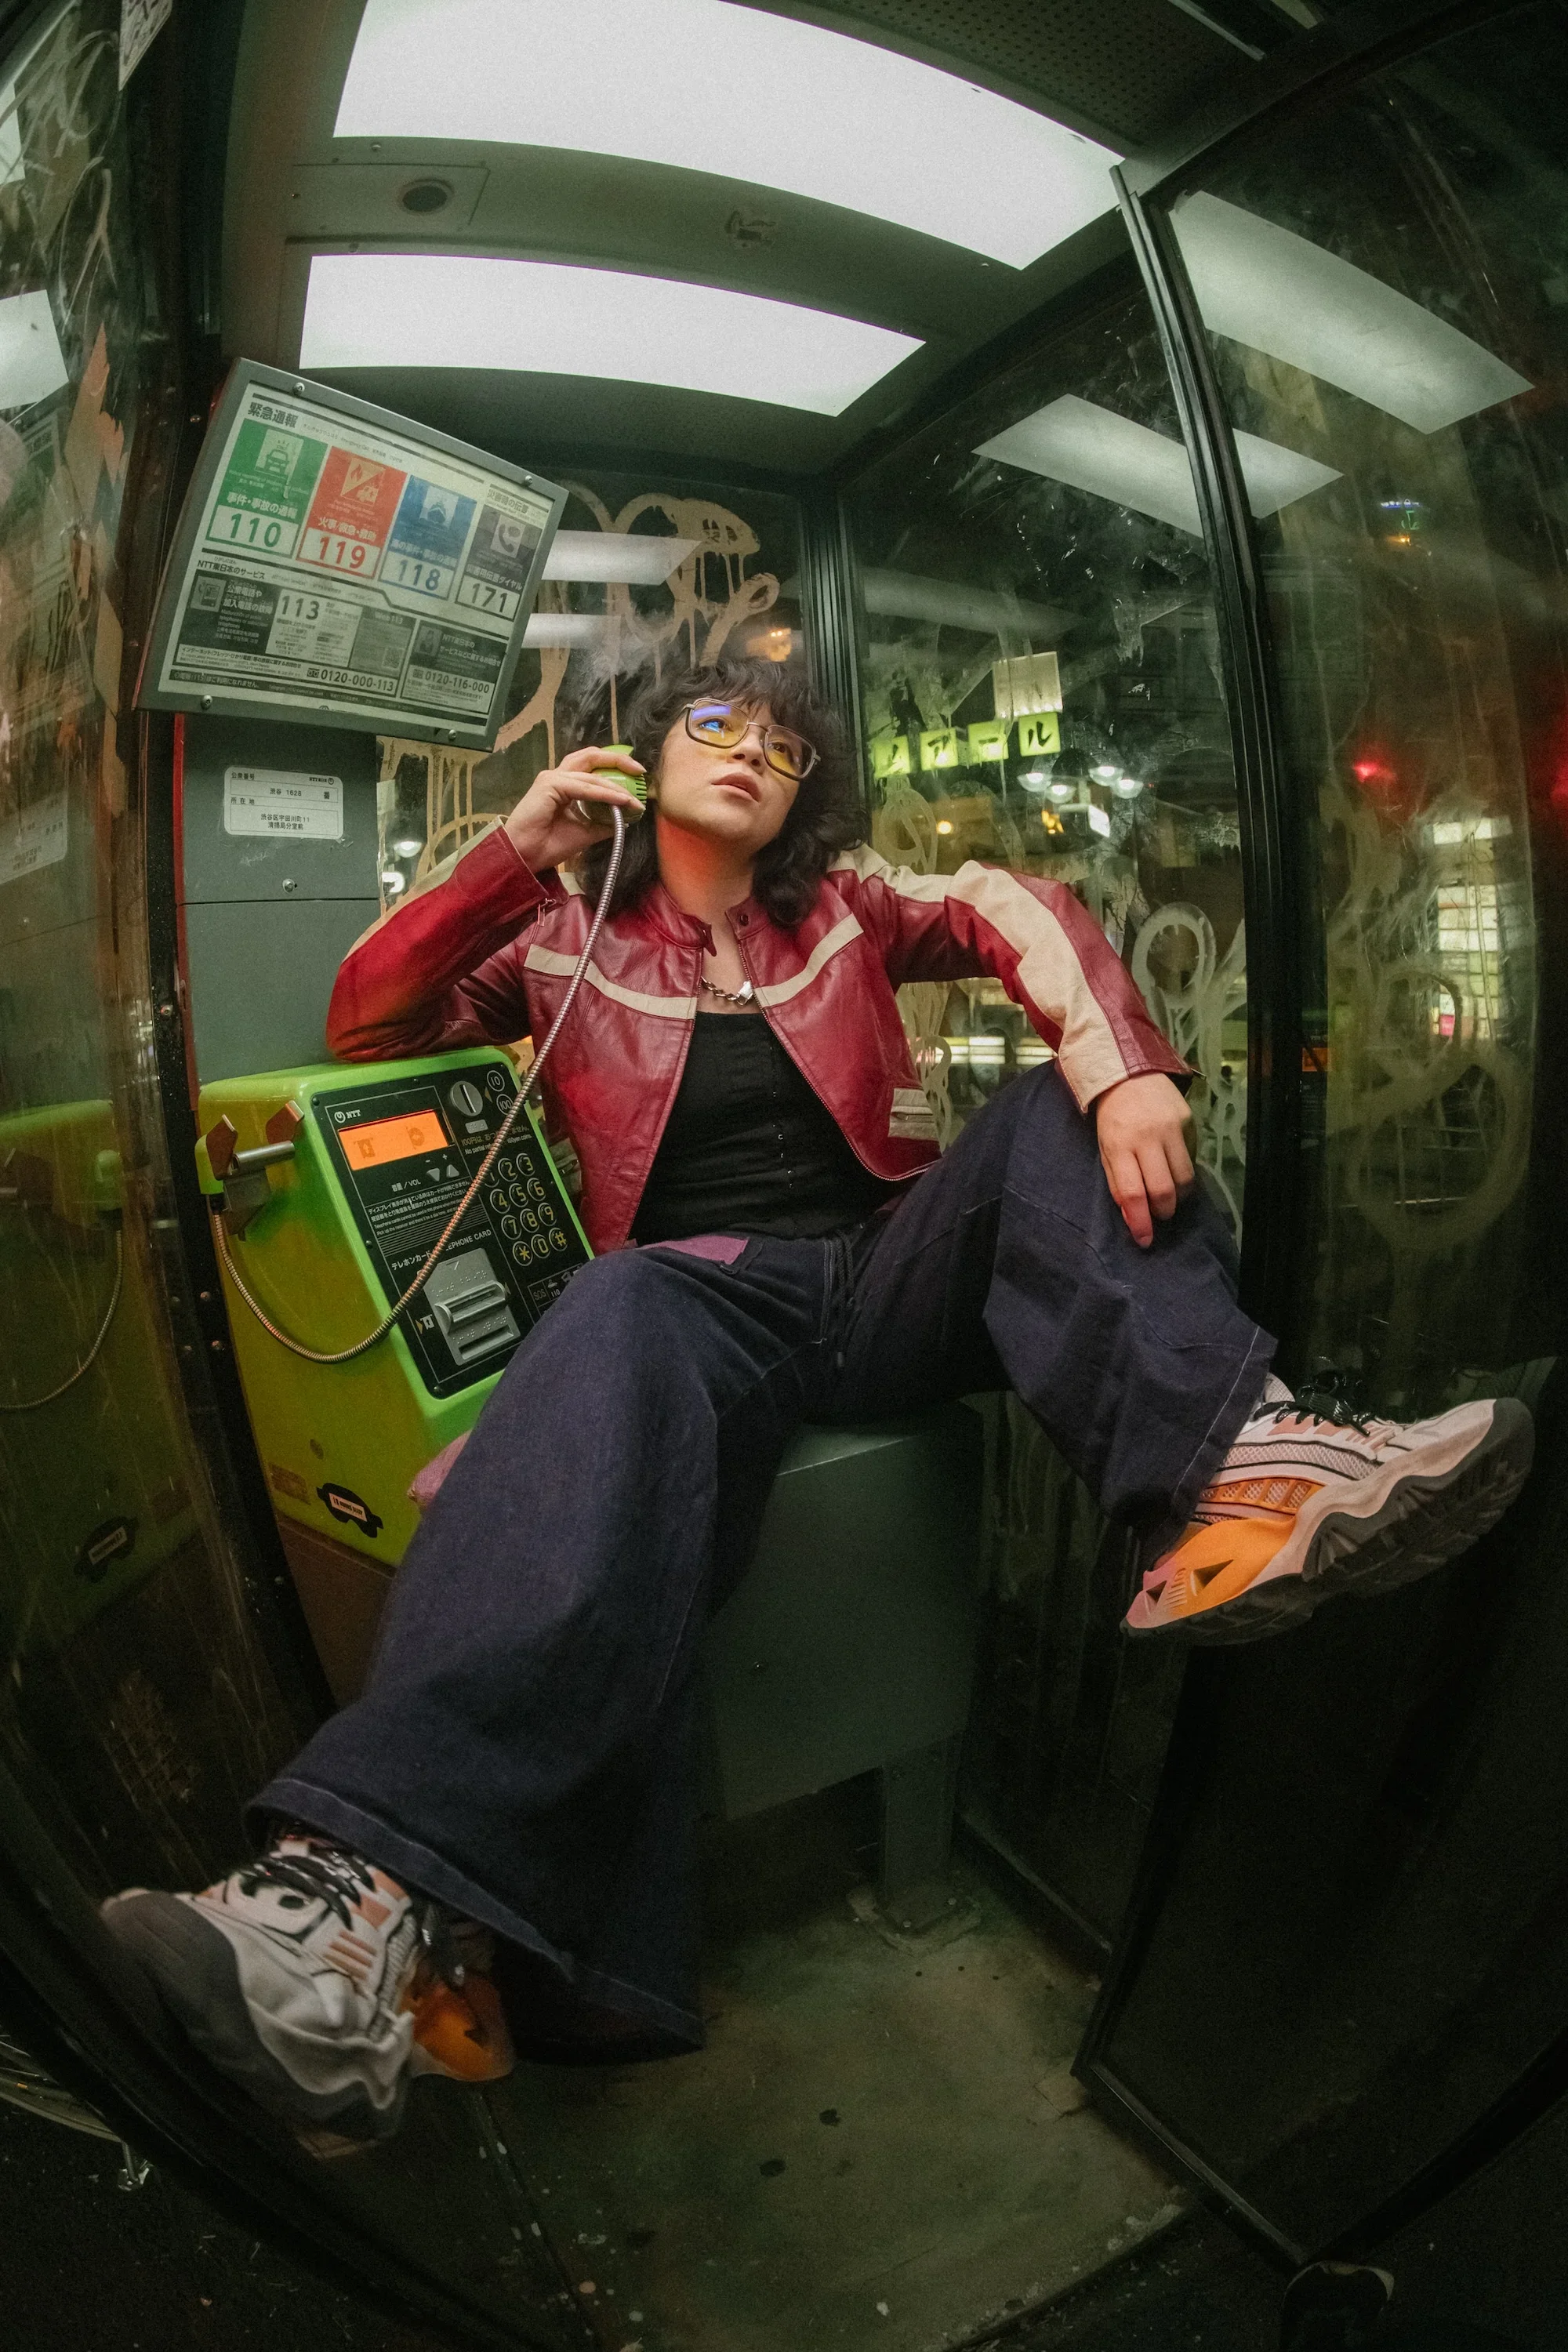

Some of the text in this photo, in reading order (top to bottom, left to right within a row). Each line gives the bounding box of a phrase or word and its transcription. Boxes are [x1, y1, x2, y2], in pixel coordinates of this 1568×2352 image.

[248, 401, 299, 428] 緊急通報
[227, 492, 298, 519] 事件・事故の通報
[230, 512, 281, 548] 110
[319, 536, 366, 569] 119
[197, 560, 266, 580] NTT東日本のサービス
[398, 560, 441, 591] 118
[282, 595, 320, 620] 113
[471, 583, 508, 613] 171
[321, 669, 394, 691] 0120-000-113
[425, 671, 490, 694] 0120-116-000
[230, 771, 255, 780] 公衆番号
[490, 1076, 500, 1086] 10
[347, 1109, 361, 1119] NTT
[499, 1102, 512, 1111] 100
[504, 1161, 516, 1177] 2
[523, 1156, 534, 1171] 3
[498, 1181, 545, 1207] 4 5 6
[508, 1205, 554, 1235] 7 8 9
[474, 1229, 492, 1240] CARD
[537, 1238, 549, 1254] 0
[533, 1288, 546, 1300] SOS
